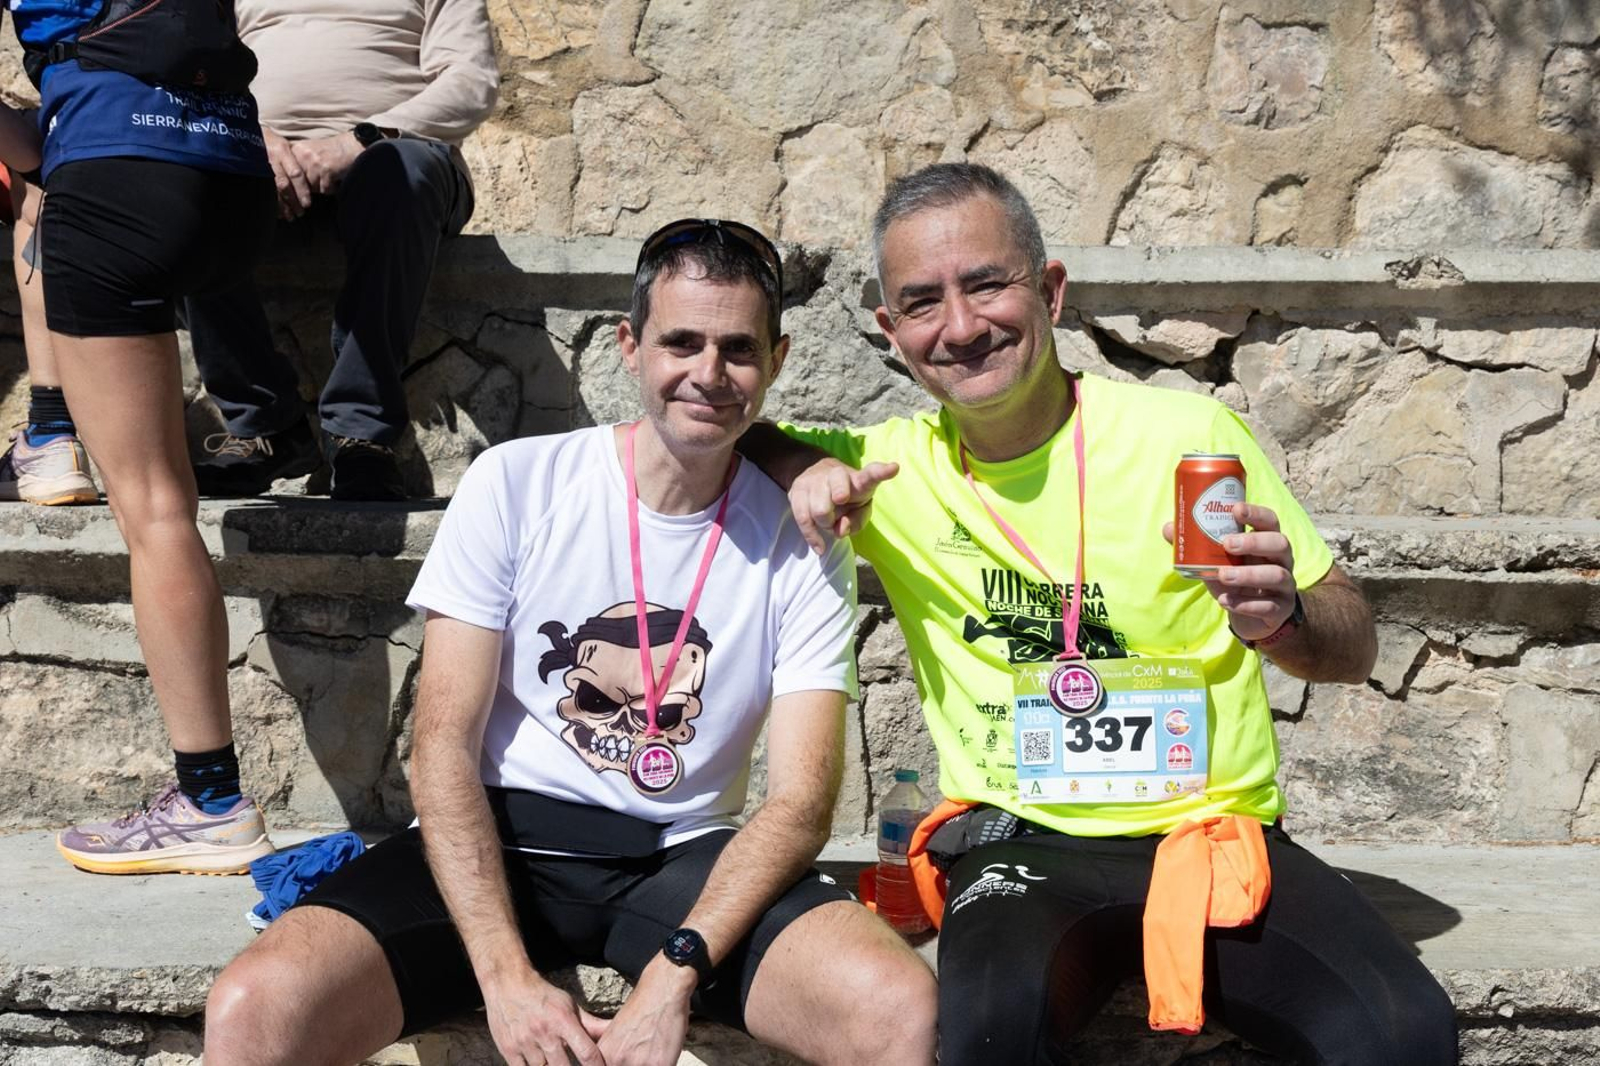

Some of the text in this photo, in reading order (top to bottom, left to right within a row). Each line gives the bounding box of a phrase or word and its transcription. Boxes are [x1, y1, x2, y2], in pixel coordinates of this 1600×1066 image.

[981, 568, 1022, 604] VIII
[1024, 577, 1104, 599] CRRERA
[988, 601, 1031, 616] NOCHE
[1035, 606, 1051, 617] DE
[1132, 664, 1163, 677] CxM
[1133, 678, 1163, 689] 2025
[1017, 698, 1051, 709] VII TRAI
[1065, 716, 1153, 753] 337
